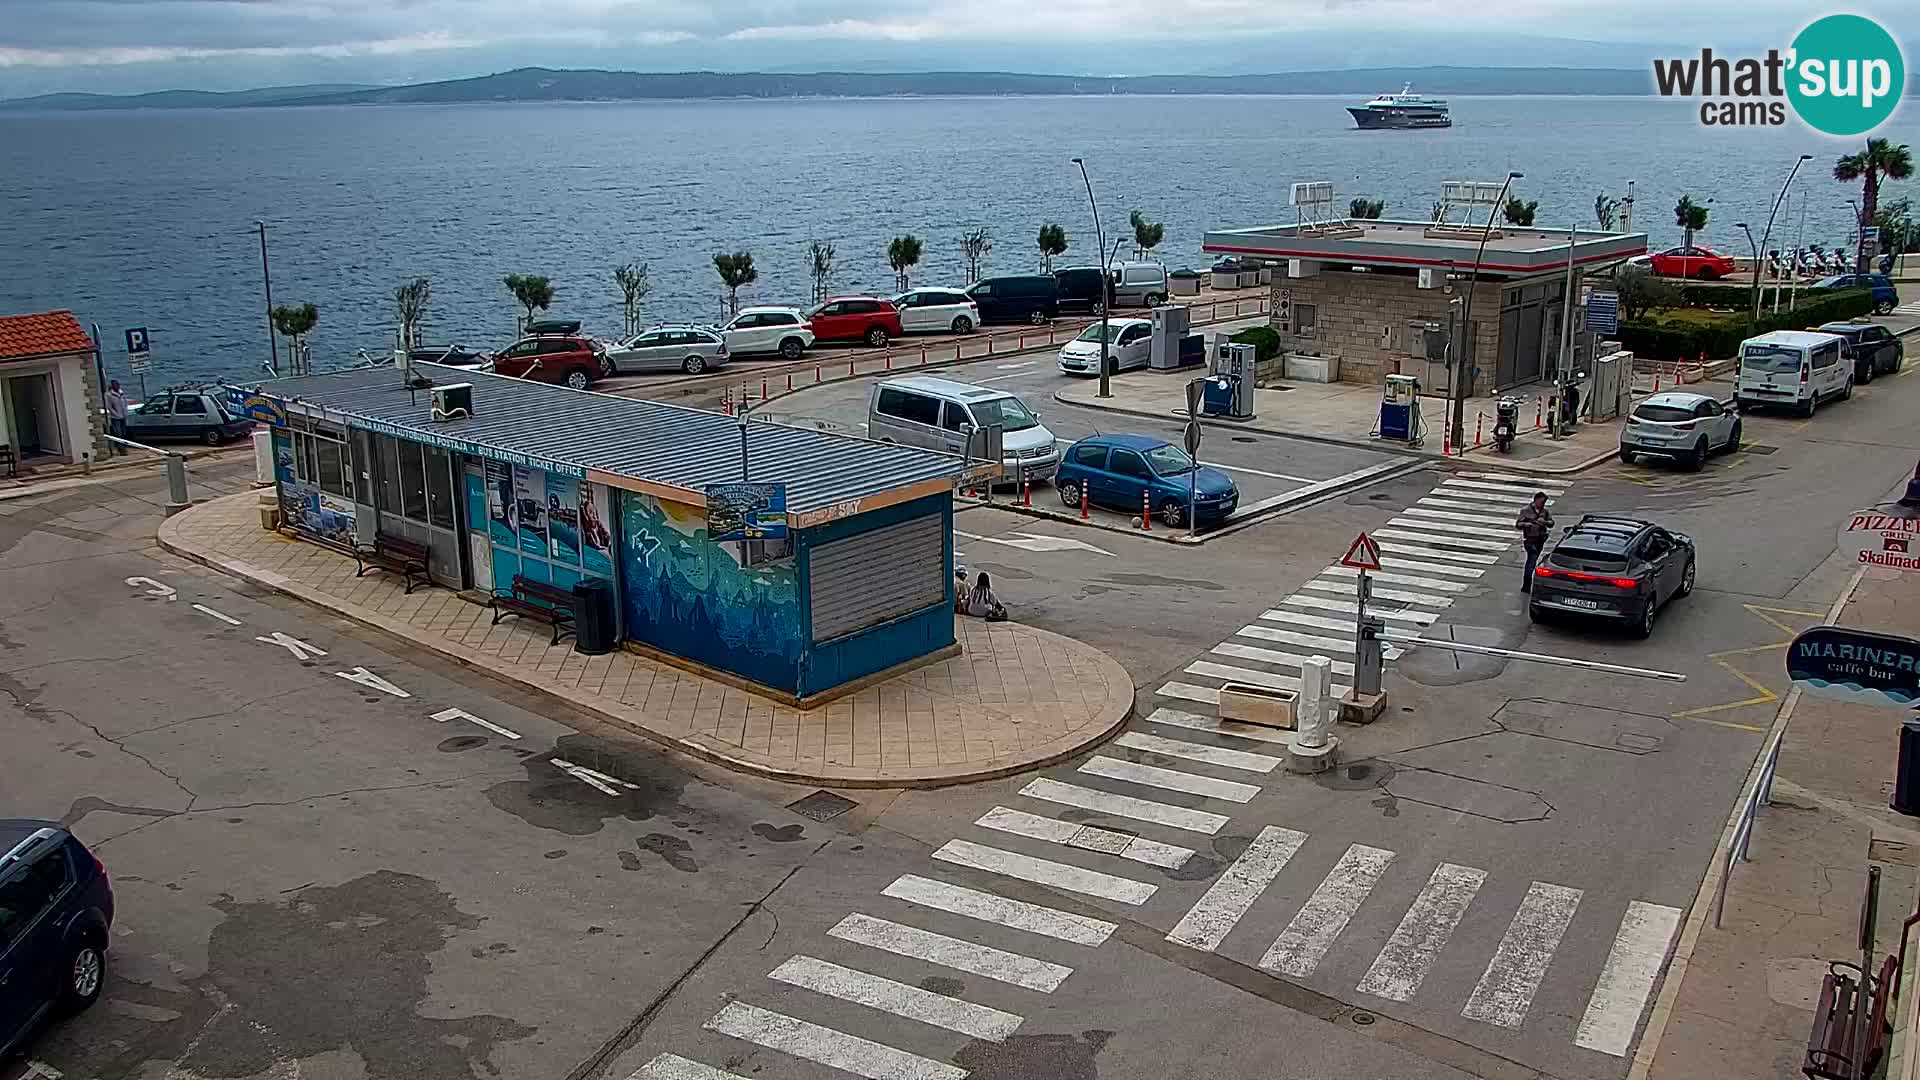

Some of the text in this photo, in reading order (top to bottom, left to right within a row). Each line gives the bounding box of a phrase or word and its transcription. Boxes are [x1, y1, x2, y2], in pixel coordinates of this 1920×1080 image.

[130, 332, 143, 349] P
[1748, 347, 1765, 355] TAXI
[396, 428, 436, 444] AUTOBUSNA
[437, 436, 468, 452] POSTAJA
[478, 446, 493, 458] BUS
[494, 450, 526, 465] STATION
[528, 457, 554, 471] TICKET
[555, 463, 582, 477] OFFICE
[1846, 515, 1920, 533] PIZZE
[1880, 531, 1916, 541] GRILL
[1869, 666, 1896, 681] bar
